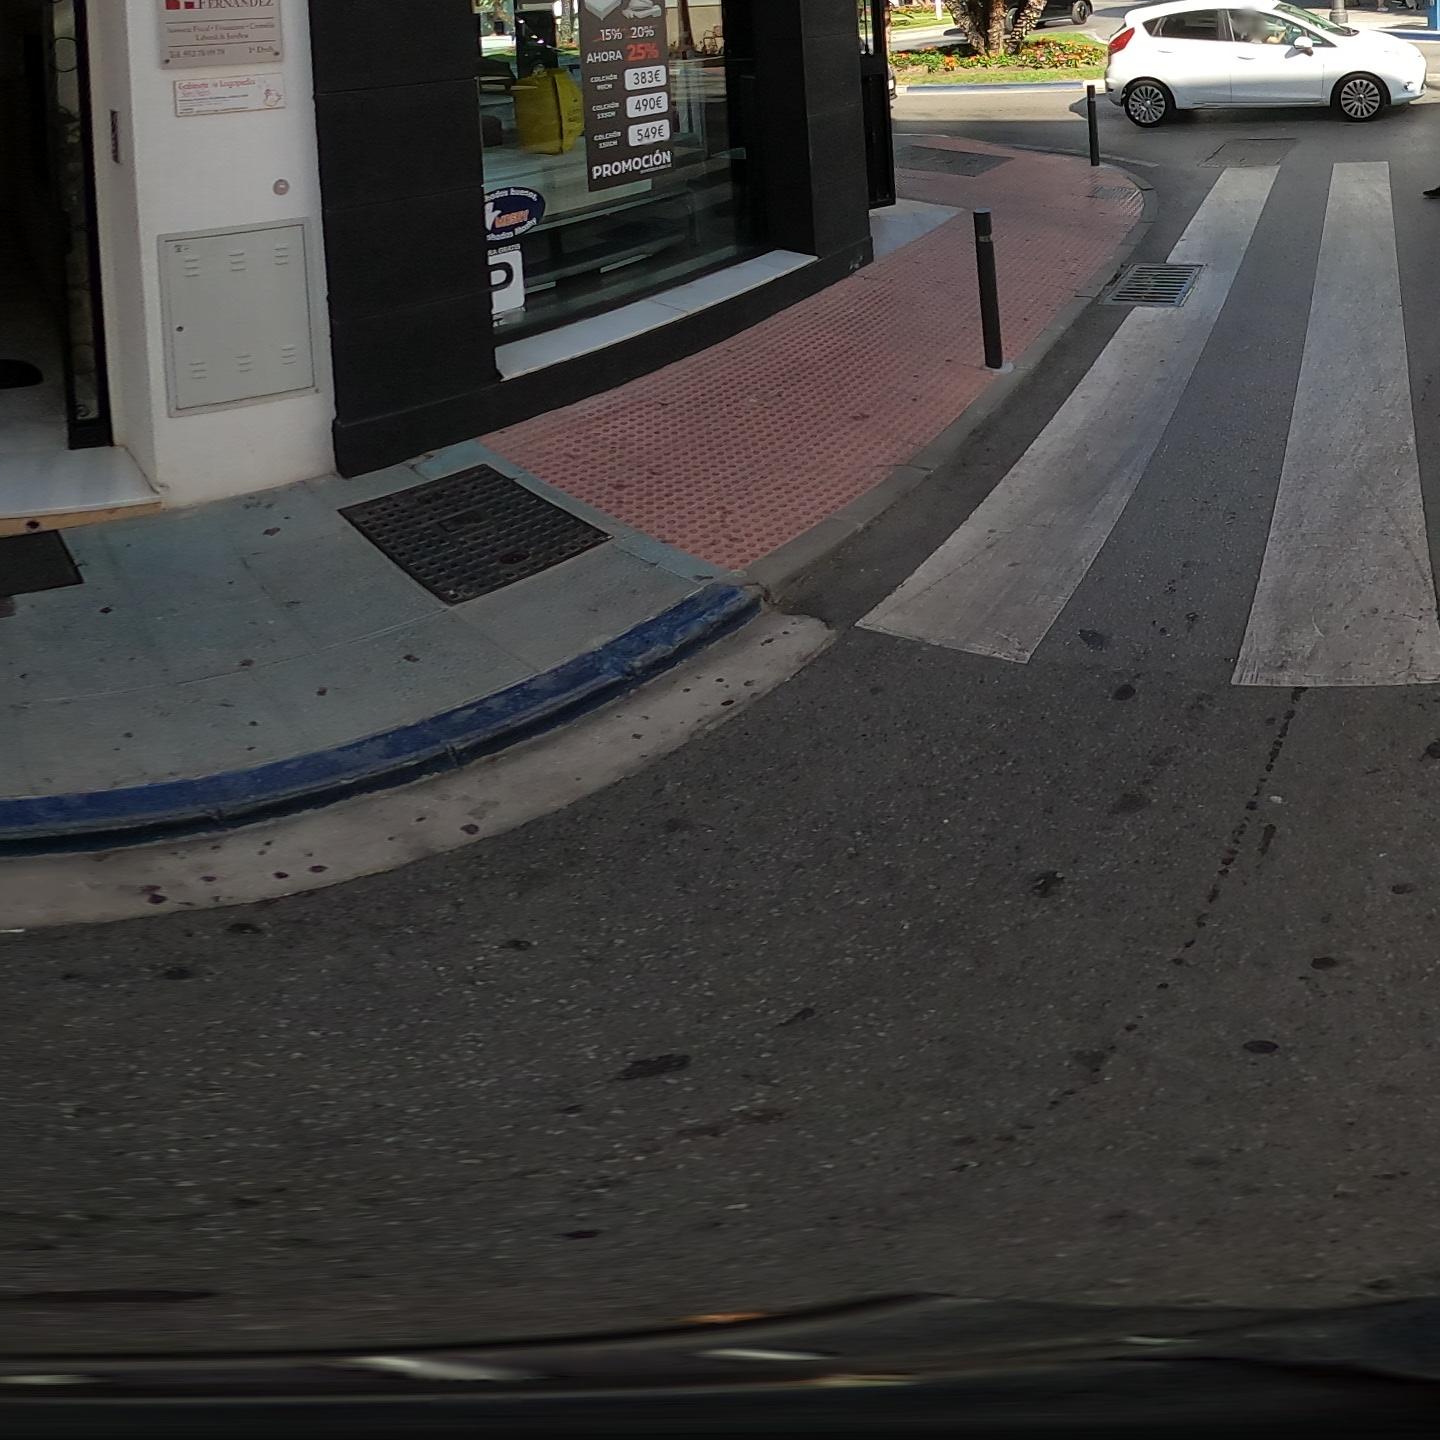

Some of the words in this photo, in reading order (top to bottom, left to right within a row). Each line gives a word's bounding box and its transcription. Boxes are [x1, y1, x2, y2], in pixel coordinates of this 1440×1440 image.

[599, 28, 622, 41] 15%
[630, 24, 655, 38] 20%
[586, 50, 623, 63] AHORA
[626, 42, 659, 61] 25%
[632, 70, 661, 85] 383€
[634, 96, 663, 112] 490€
[636, 125, 665, 142] 549€
[592, 150, 671, 179] PROMOCIÓN
